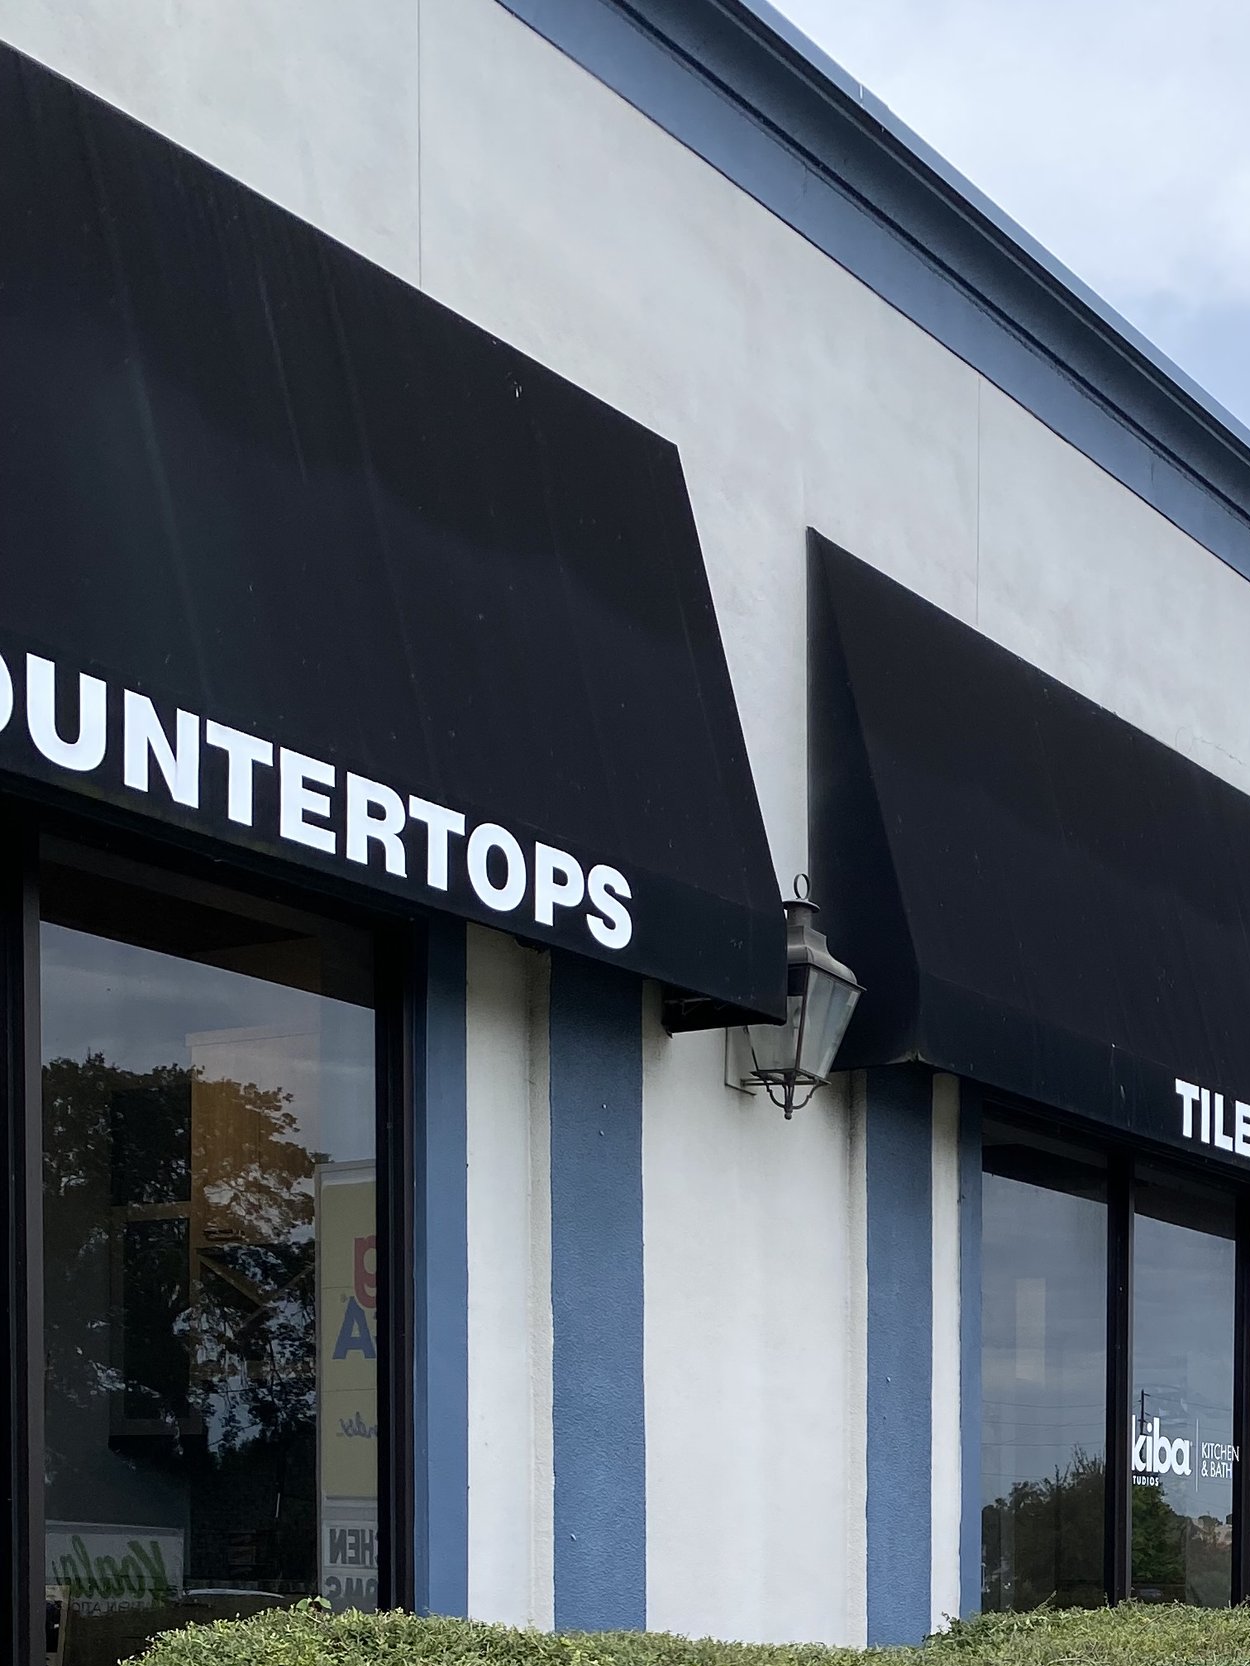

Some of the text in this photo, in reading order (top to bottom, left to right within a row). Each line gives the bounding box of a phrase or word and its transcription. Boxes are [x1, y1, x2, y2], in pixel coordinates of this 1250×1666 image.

[0, 652, 633, 950] UNTERTOPS
[1201, 1442, 1239, 1462] KITCHEN
[1201, 1460, 1232, 1479] & BATH
[1132, 1475, 1159, 1487] TUDIOS
